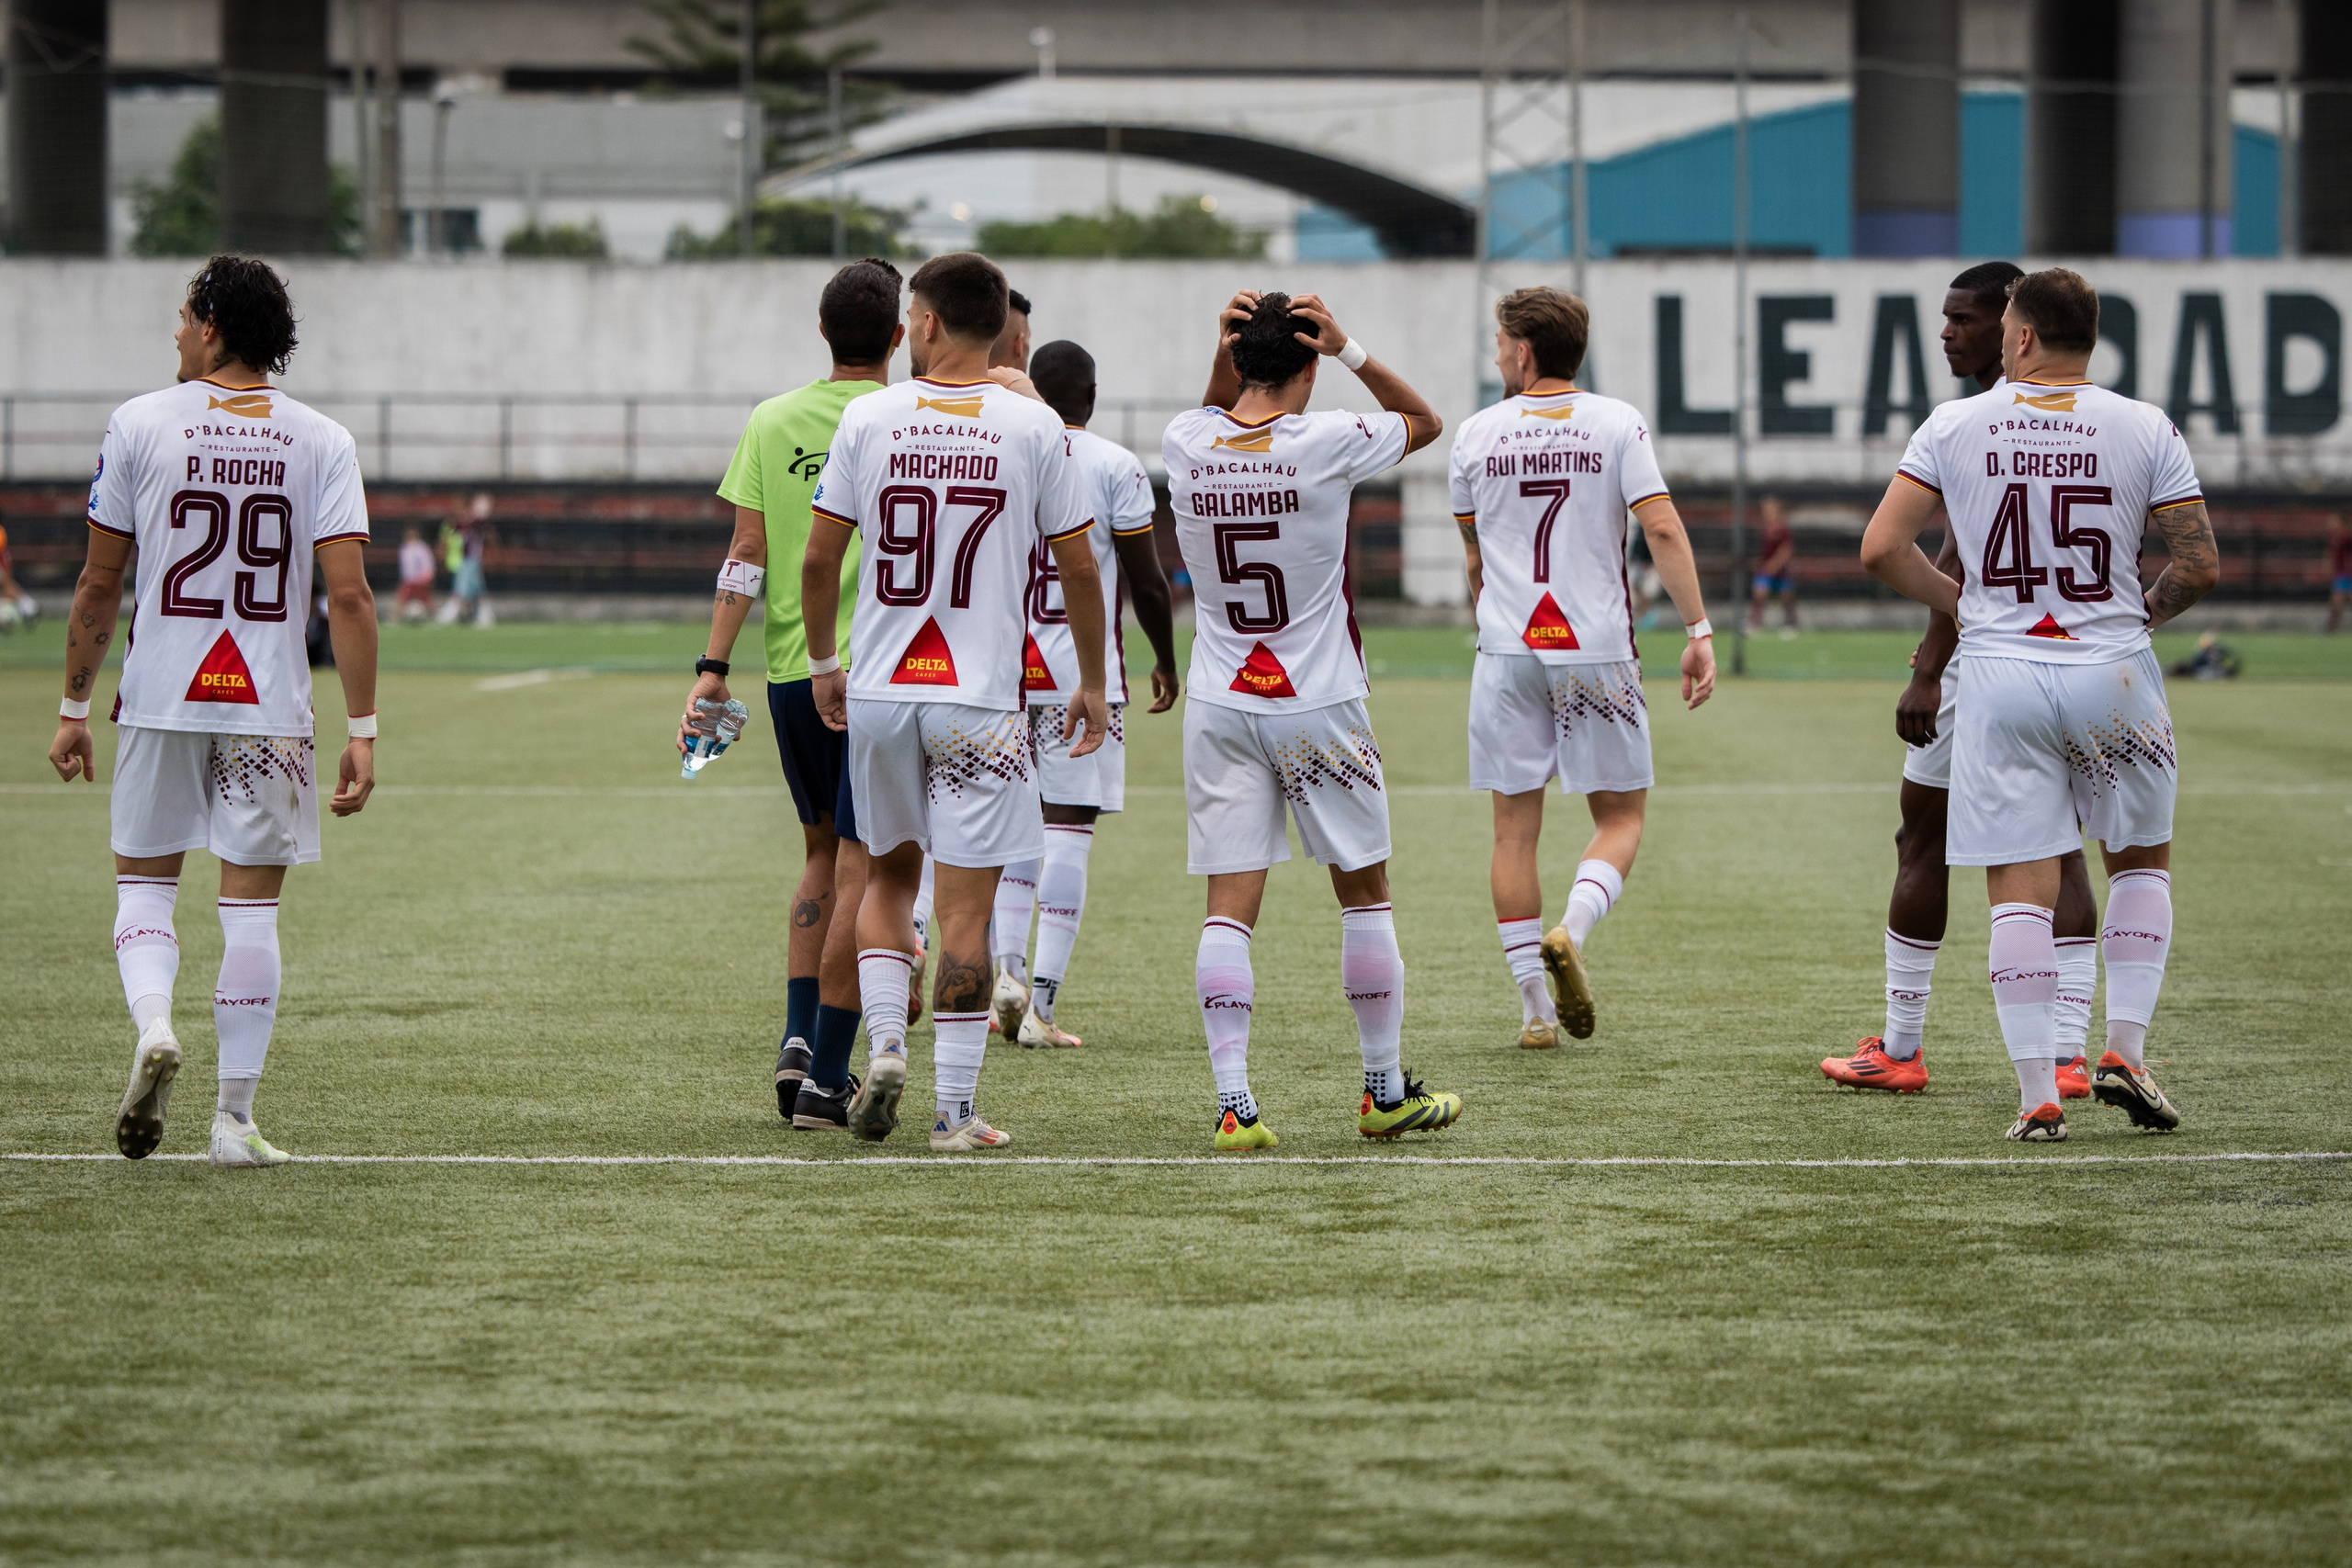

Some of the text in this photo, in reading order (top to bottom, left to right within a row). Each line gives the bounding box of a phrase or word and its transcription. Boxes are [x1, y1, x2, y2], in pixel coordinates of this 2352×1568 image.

[184, 425, 294, 446] D'BACALHAU
[892, 424, 1002, 446] D'BACALHAU
[1499, 426, 1590, 445] D'BACALHAU
[1988, 419, 2097, 437] D'BACALHAU
[208, 444, 271, 453] RESTAURANTE
[2011, 438, 2072, 446] RESTAURANTE
[187, 456, 286, 487] P. ROCHA
[889, 453, 999, 481] MACHADO
[1190, 462, 1297, 480] D'BACALHAU
[1487, 451, 1602, 478] RUI MARTINS
[1986, 450, 2098, 479] D. CRESPO
[1212, 481, 1273, 490] RESTAURANTE
[1191, 489, 1300, 517] GALAMBA
[1519, 479, 1570, 584] 7
[876, 484, 1008, 610] 97
[1981, 482, 2114, 604] 45
[160, 489, 293, 623] 29
[1213, 520, 1290, 635] 5
[1530, 626, 1569, 638] DELTA
[906, 658, 948, 671] DELTA
[1025, 667, 1046, 678] LTA
[201, 673, 247, 688] DELTA
[1242, 671, 1283, 685] DELTA
[1345, 990, 1392, 1000] LAYOFF
[1214, 1000, 1252, 1015] PLAYO
